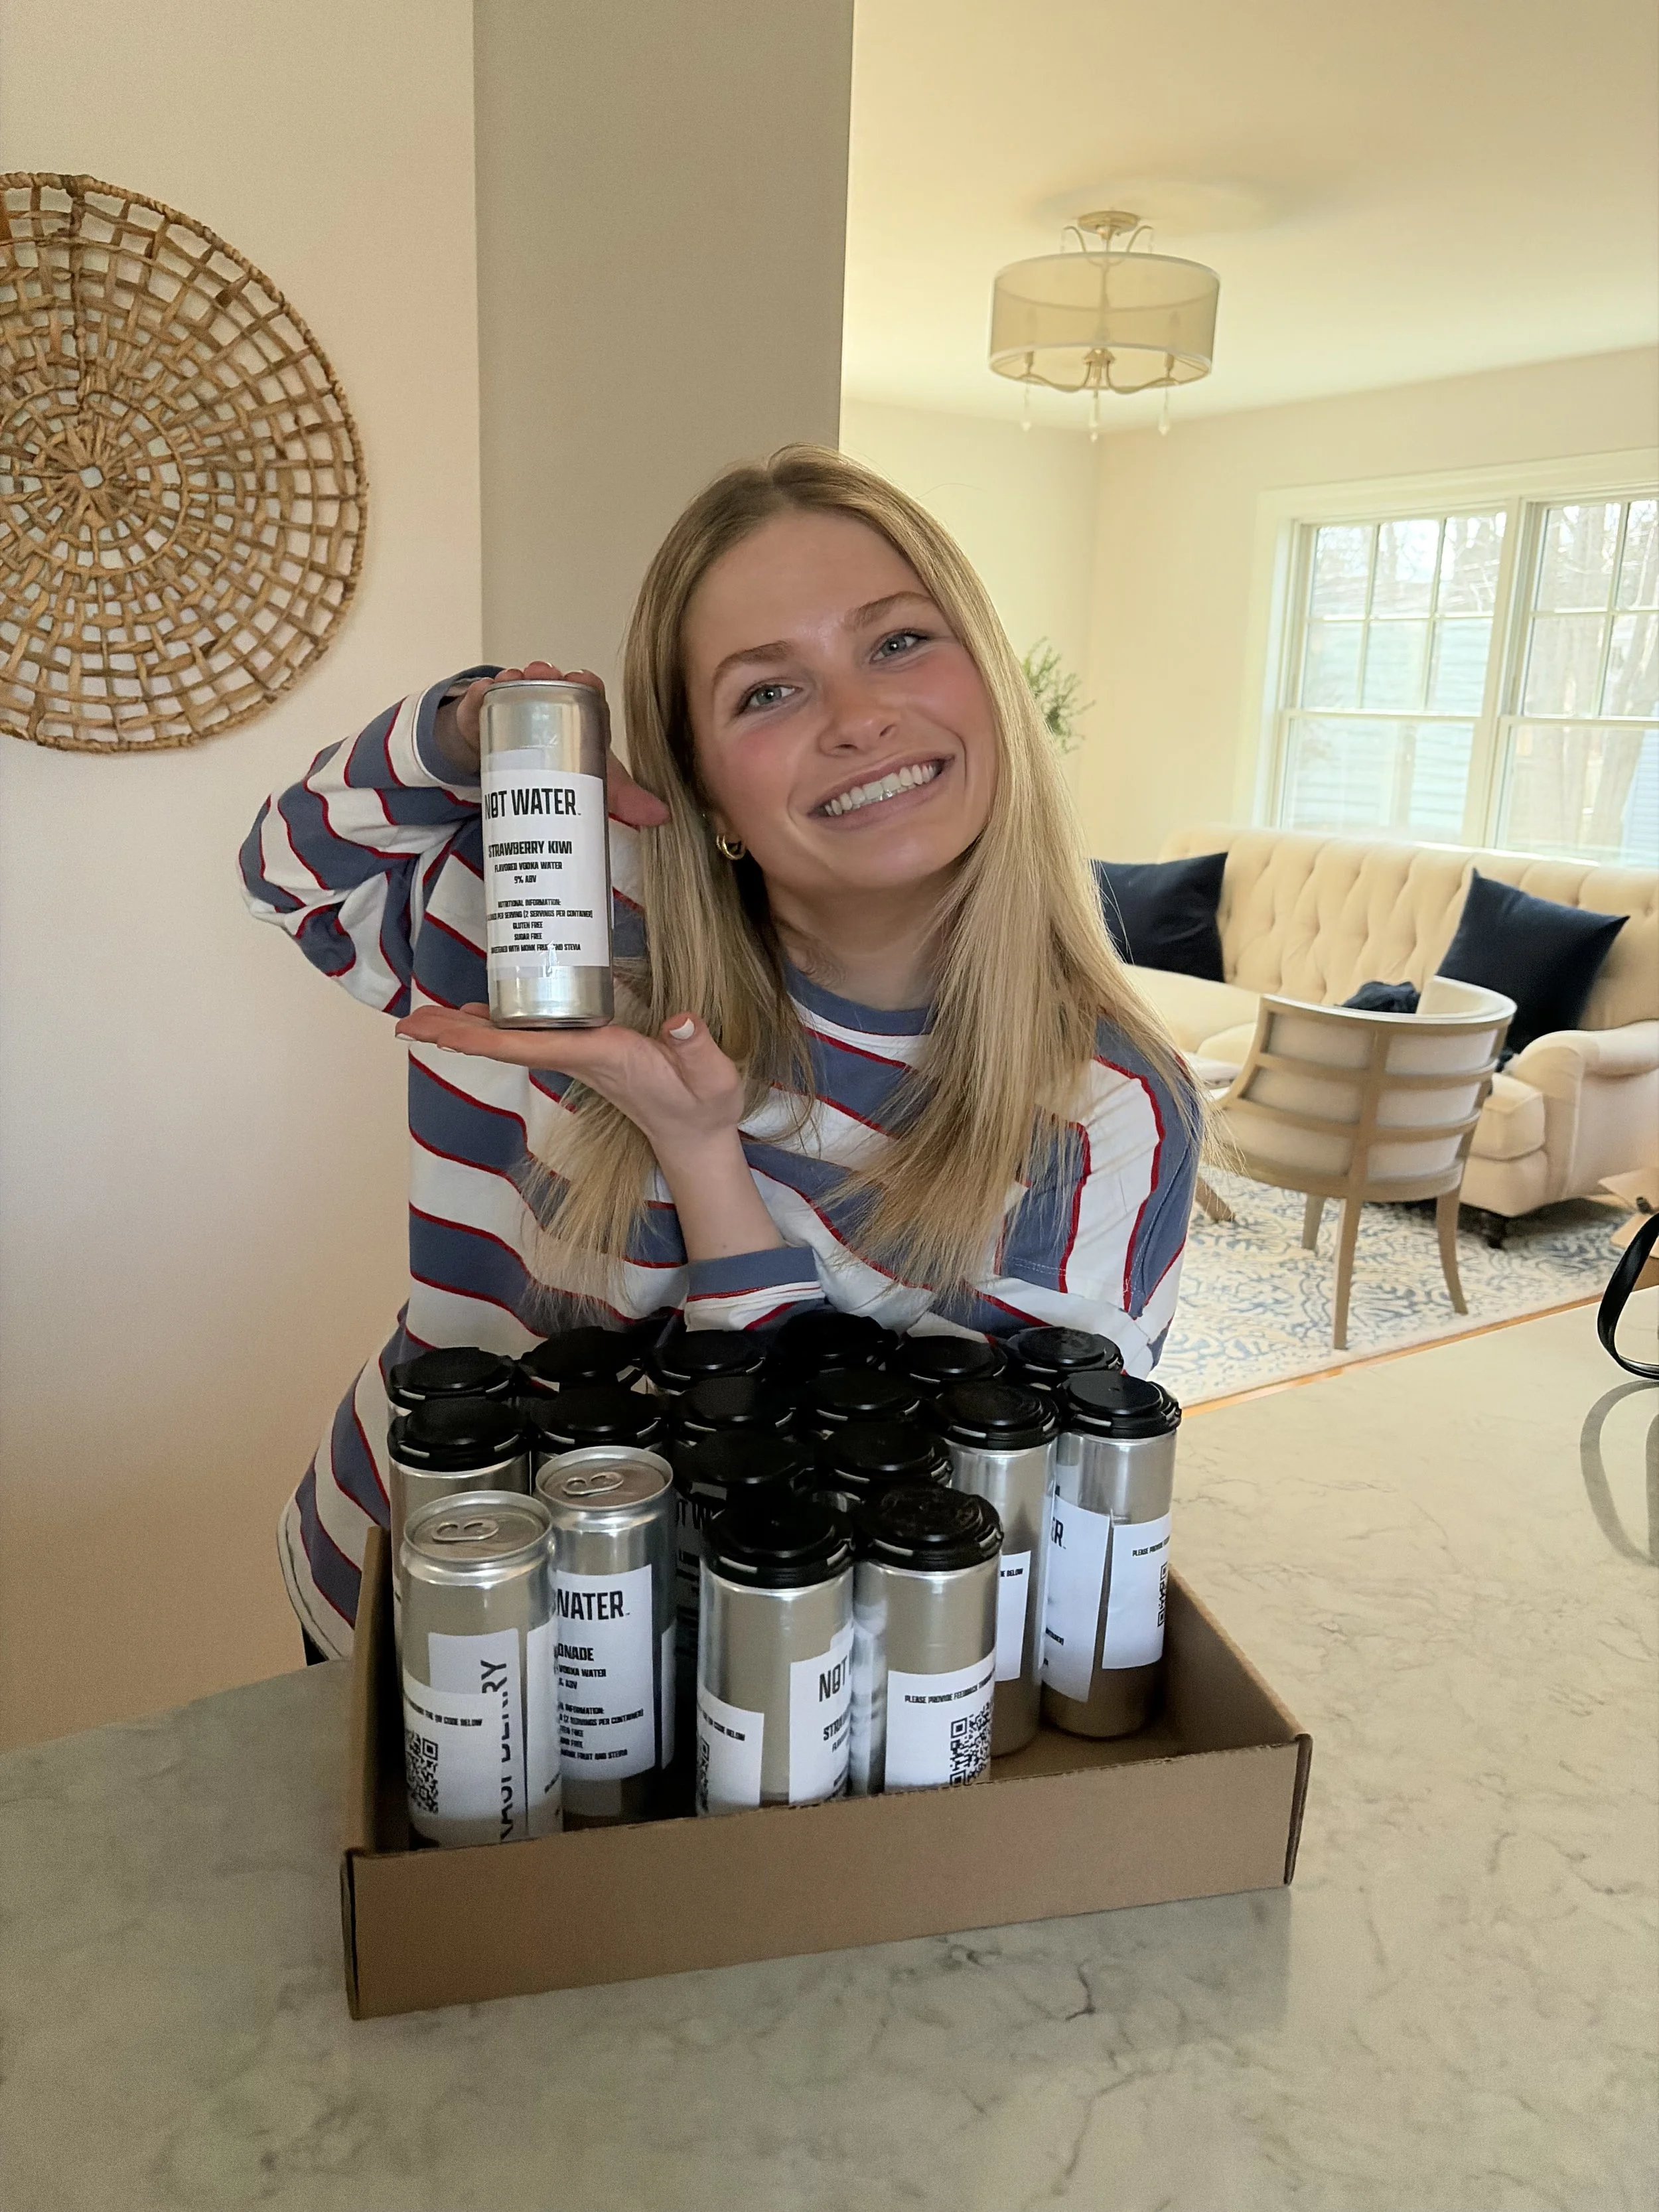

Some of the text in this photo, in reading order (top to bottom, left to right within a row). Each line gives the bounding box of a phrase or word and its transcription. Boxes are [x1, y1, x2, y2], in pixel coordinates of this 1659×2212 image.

[488, 841, 573, 858] STRAWBERRY KIWI
[494, 863, 518, 873] FLAVORED
[498, 900, 524, 909] NUTRITIONAL
[523, 910, 529, 919] (2
[567, 910, 593, 919] CONTAINER)
[1132, 1547, 1149, 1556] PLEASE
[1006, 1568, 1023, 1577] BELOW
[557, 1643, 594, 1661] ONADE
[581, 1668, 607, 1677] WATER
[904, 1694, 927, 1704] PLEASE
[928, 1693, 954, 1704] PROVIDE
[460, 1718, 483, 1727] BELOW
